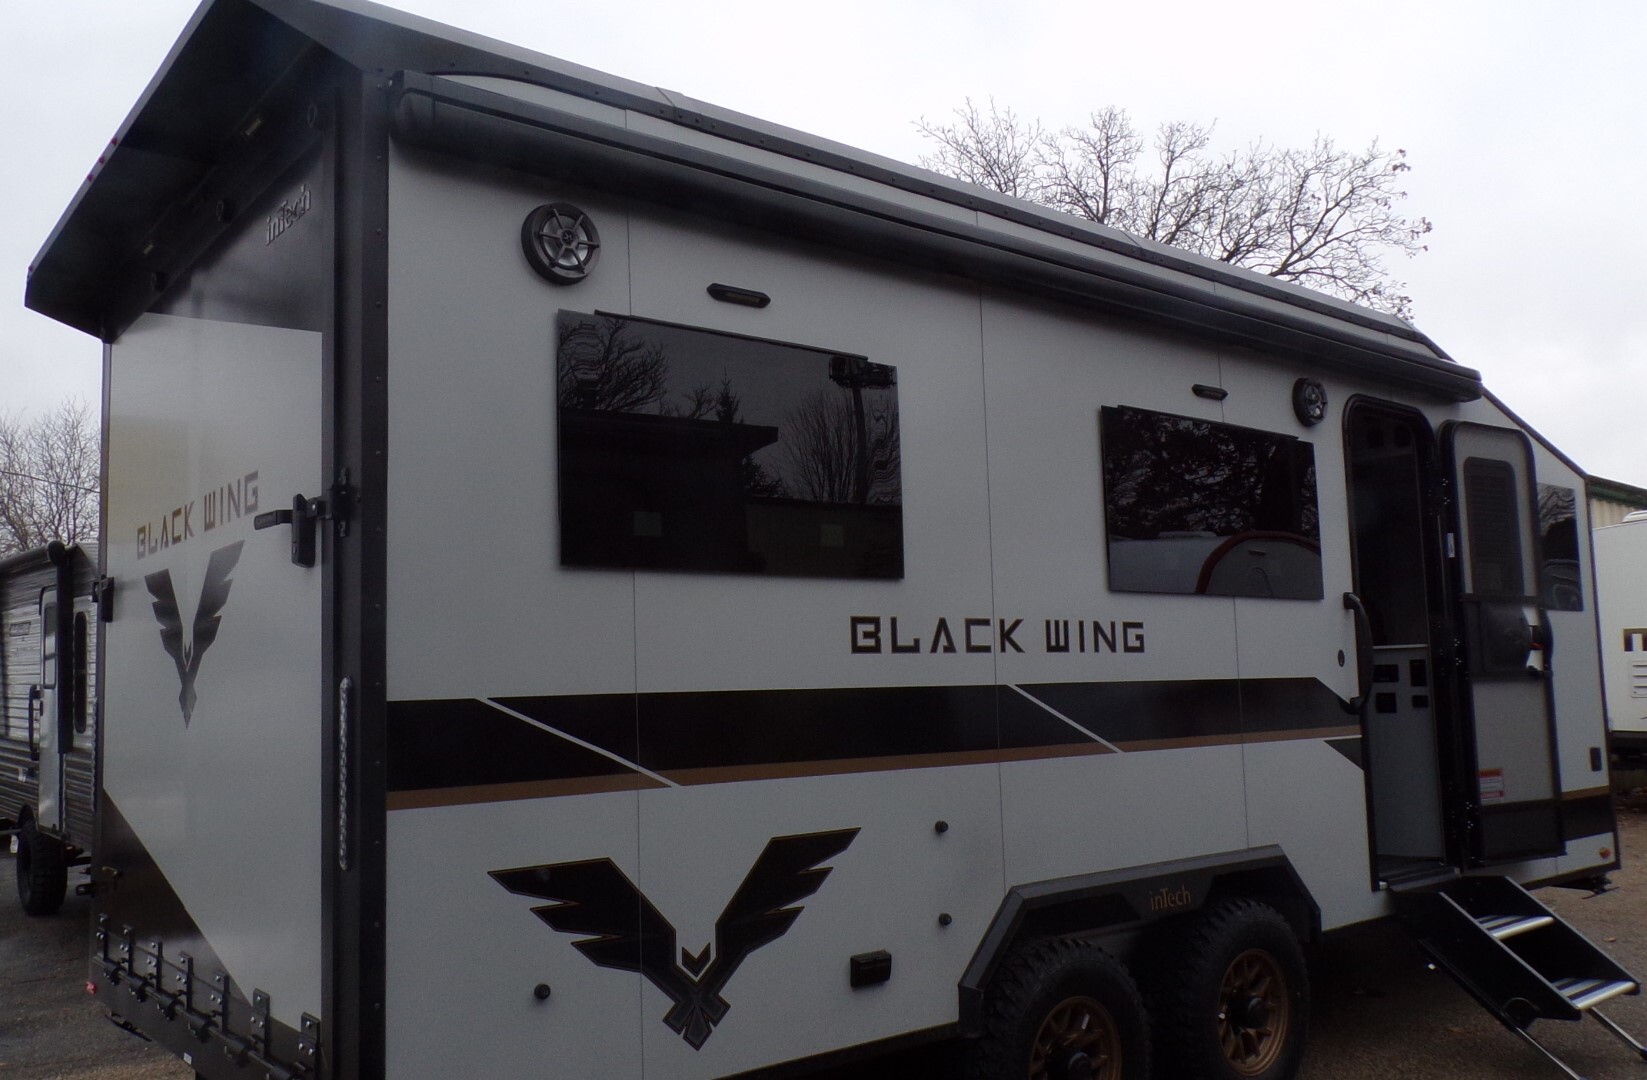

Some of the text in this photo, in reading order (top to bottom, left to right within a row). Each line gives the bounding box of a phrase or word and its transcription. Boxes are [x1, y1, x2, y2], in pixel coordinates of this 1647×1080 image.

[265, 185, 311, 246] inTech
[137, 470, 259, 560] BLACK WING
[850, 616, 1145, 654] BLACK WING
[1149, 884, 1191, 910] inTech
